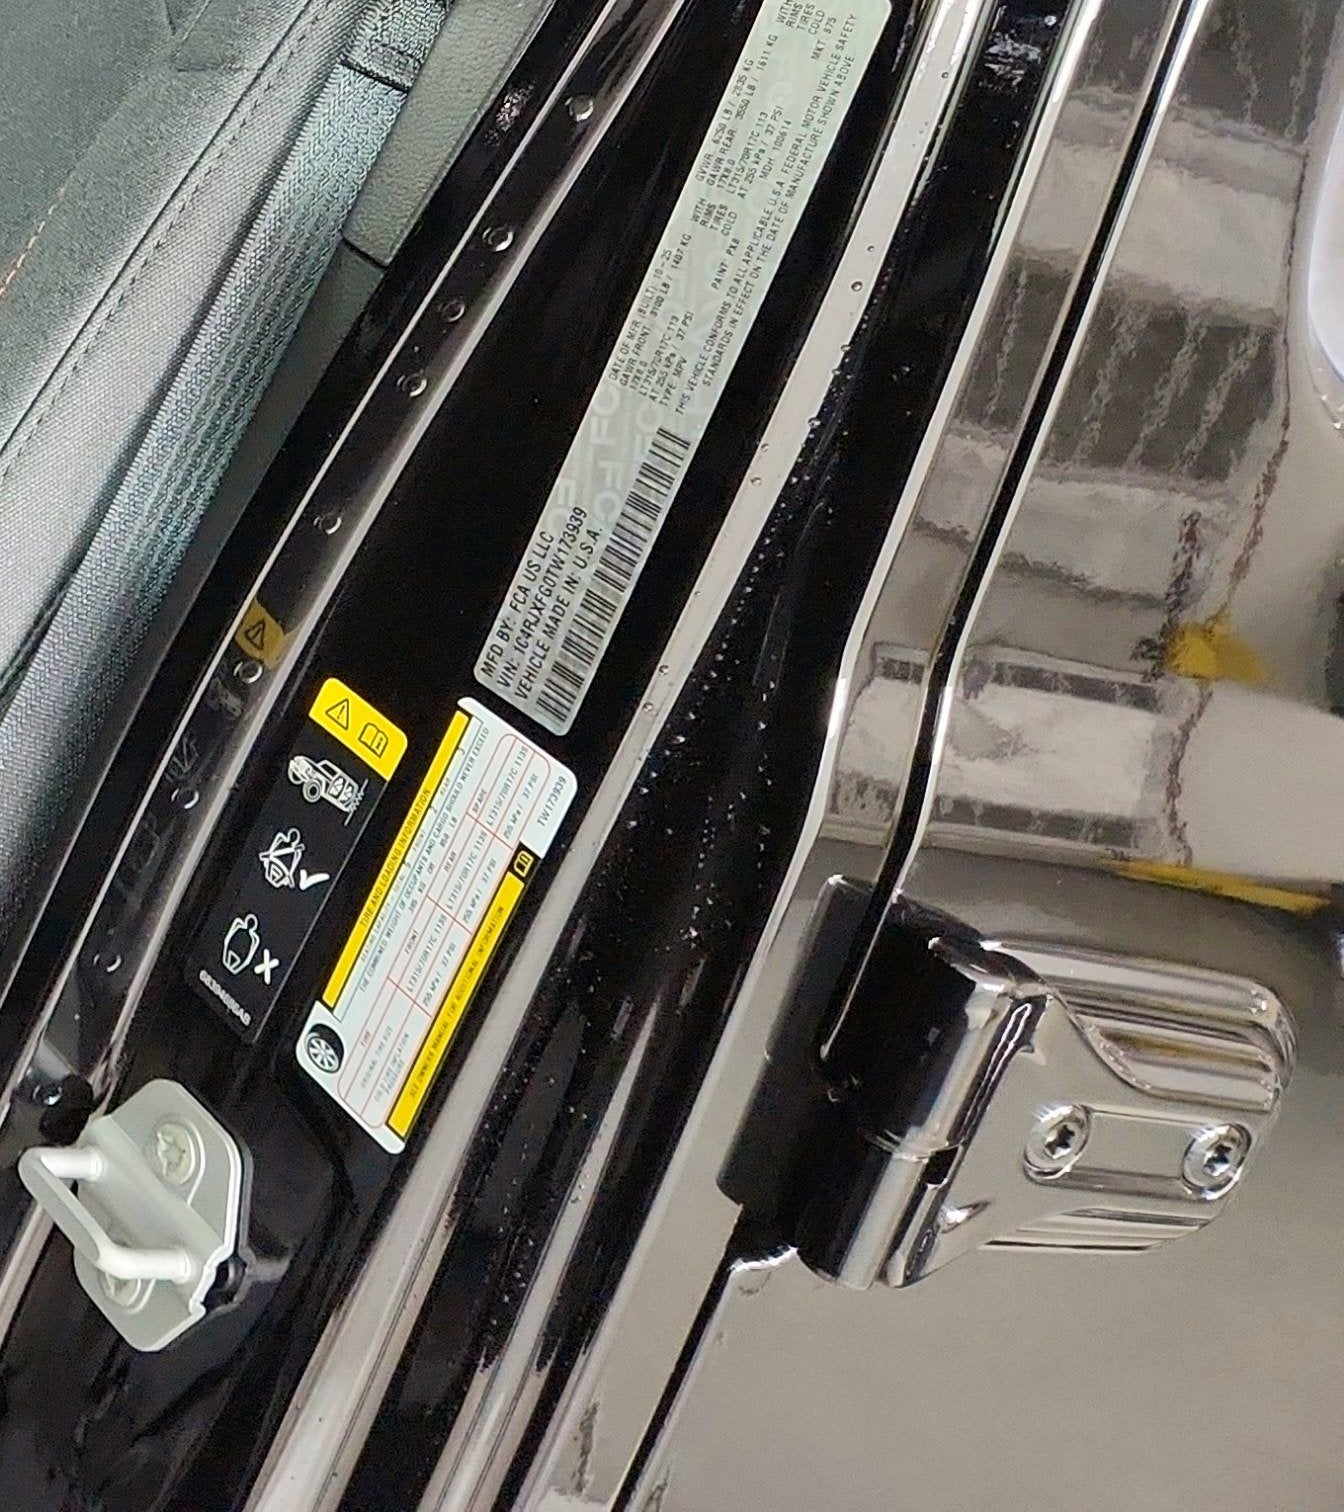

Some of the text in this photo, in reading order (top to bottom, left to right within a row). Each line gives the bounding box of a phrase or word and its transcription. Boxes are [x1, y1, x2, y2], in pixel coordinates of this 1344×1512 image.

[785, 1, 803, 27] RIMS
[796, 2, 816, 31] TIRES
[807, 9, 826, 36] COLD
[705, 156, 725, 186] GAWR
[764, 33, 778, 47] KG
[754, 109, 769, 128] 113
[816, 87, 841, 126] SHOWN
[784, 126, 824, 199] MANUFACTURE
[736, 185, 749, 199] AT
[743, 165, 758, 184] 255
[674, 391, 691, 415] THIS
[684, 352, 709, 392] VEHICLE
[702, 299, 732, 353] CONFORMS
[725, 284, 739, 299] TO
[732, 265, 748, 285] ALL
[740, 207, 774, 265] APPLICABLE
[780, 130, 808, 175] FEDERAL
[800, 93, 824, 130] MOTOR
[816, 52, 842, 94] VEHICLE
[834, 12, 860, 52] SAFETY
[688, 195, 707, 222] WITH
[699, 201, 717, 227] RIMS
[709, 202, 729, 232] TIRES
[777, 199, 791, 215] OF
[720, 210, 738, 237] COLD
[765, 215, 784, 242] DATE
[755, 242, 772, 263] THE
[748, 263, 763, 280] ON
[618, 356, 638, 387] GAWR
[668, 246, 685, 269] 1407
[677, 231, 691, 247] KG
[732, 279, 755, 316] EFFECT
[608, 355, 625, 381] DATE
[619, 342, 631, 355] OF
[659, 246, 672, 260] 25
[665, 313, 680, 332] 113
[726, 315, 739, 328] IN
[672, 355, 688, 378] MPV
[700, 328, 734, 387] STANDARDS
[648, 388, 660, 402] AT
[480, 528, 553, 678] MFD BY: FCA US LLC
[514, 639, 551, 702] VEHICLE
[541, 594, 570, 640] MADE
[561, 569, 581, 594] IN:
[571, 521, 602, 570] U.S.A.
[496, 654, 520, 690] VIN:
[536, 773, 567, 828] TW173939
[359, 906, 373, 929] TIRE
[369, 886, 383, 907] AND
[378, 847, 401, 888] LOADING
[397, 786, 431, 848] INFORMATION
